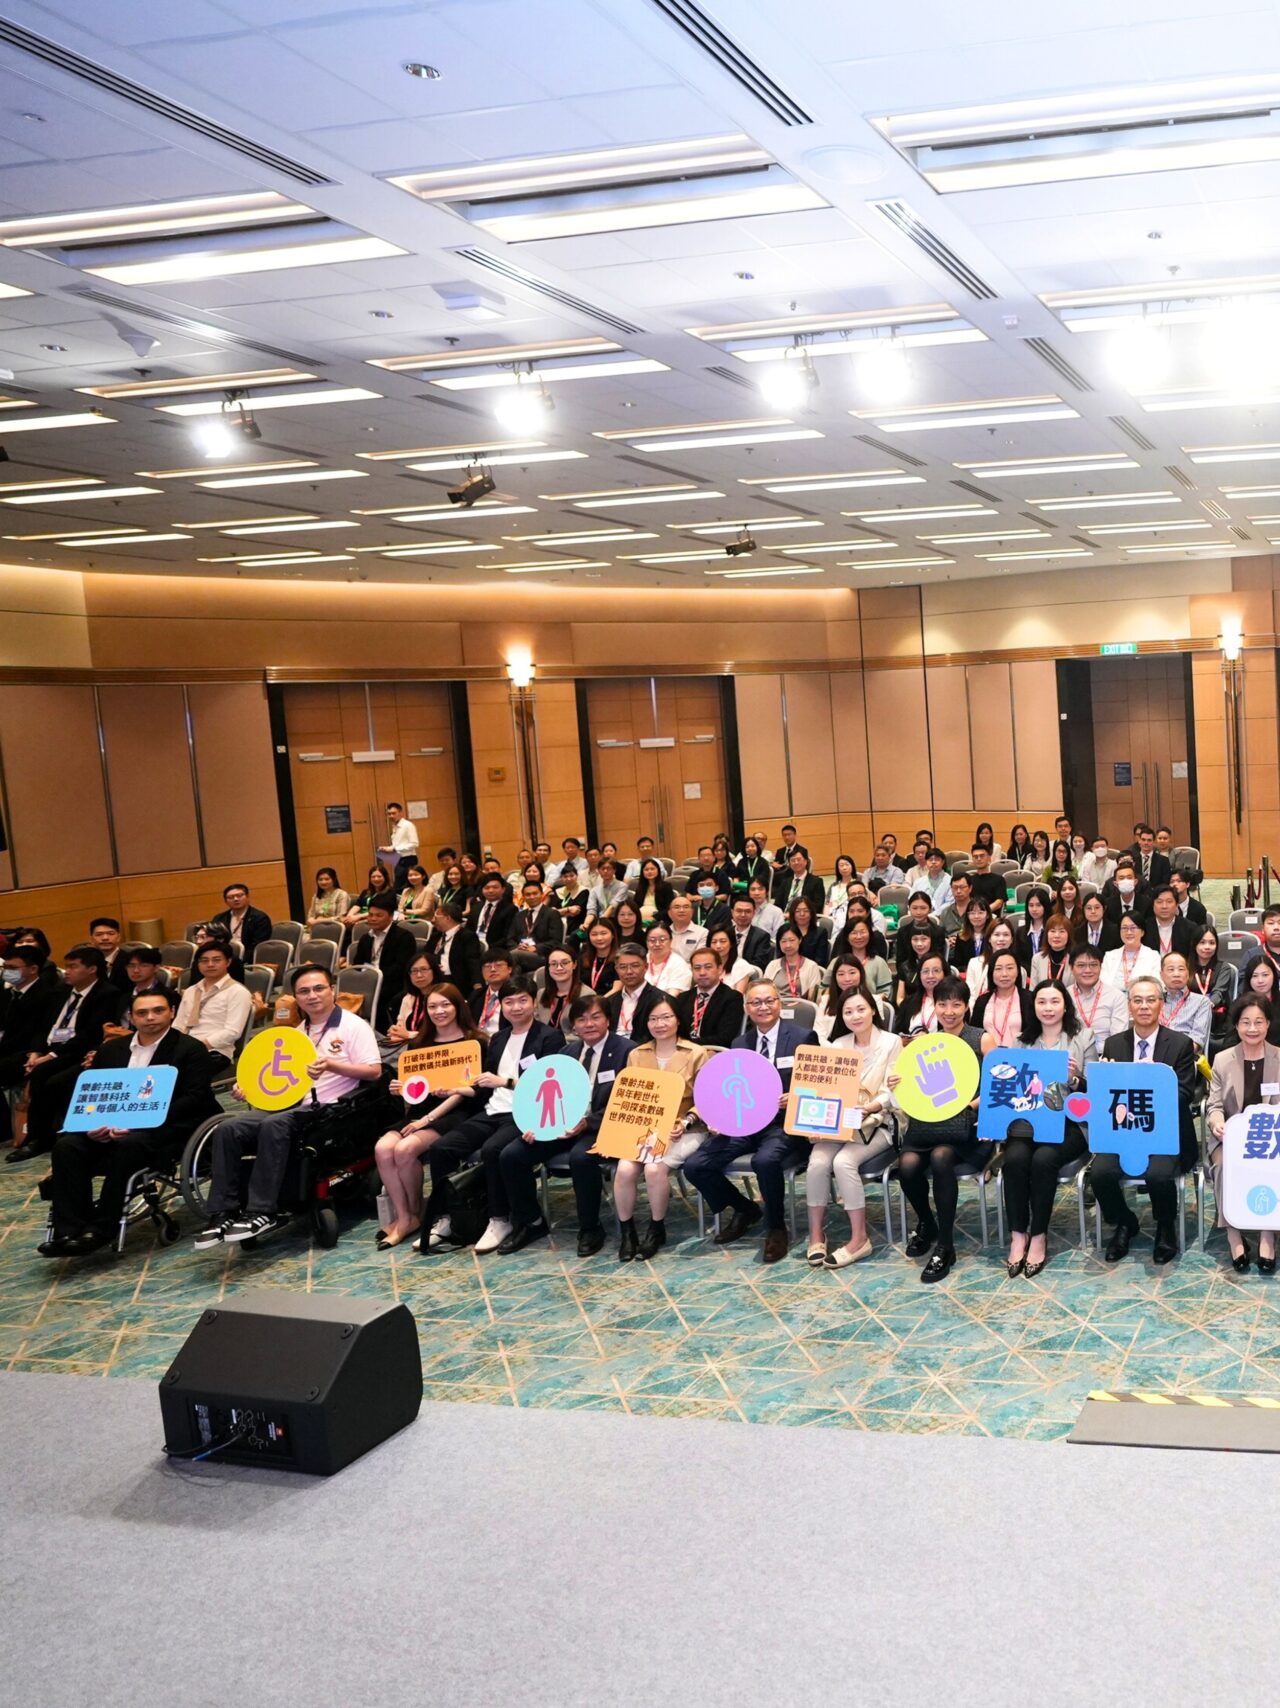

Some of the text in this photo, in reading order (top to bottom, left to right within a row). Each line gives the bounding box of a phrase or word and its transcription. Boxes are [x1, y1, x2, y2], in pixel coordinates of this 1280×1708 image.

[76, 1092, 131, 1104] 讓智慧科技
[615, 1088, 660, 1104] 與年輕世代
[1108, 1088, 1155, 1133] 碼
